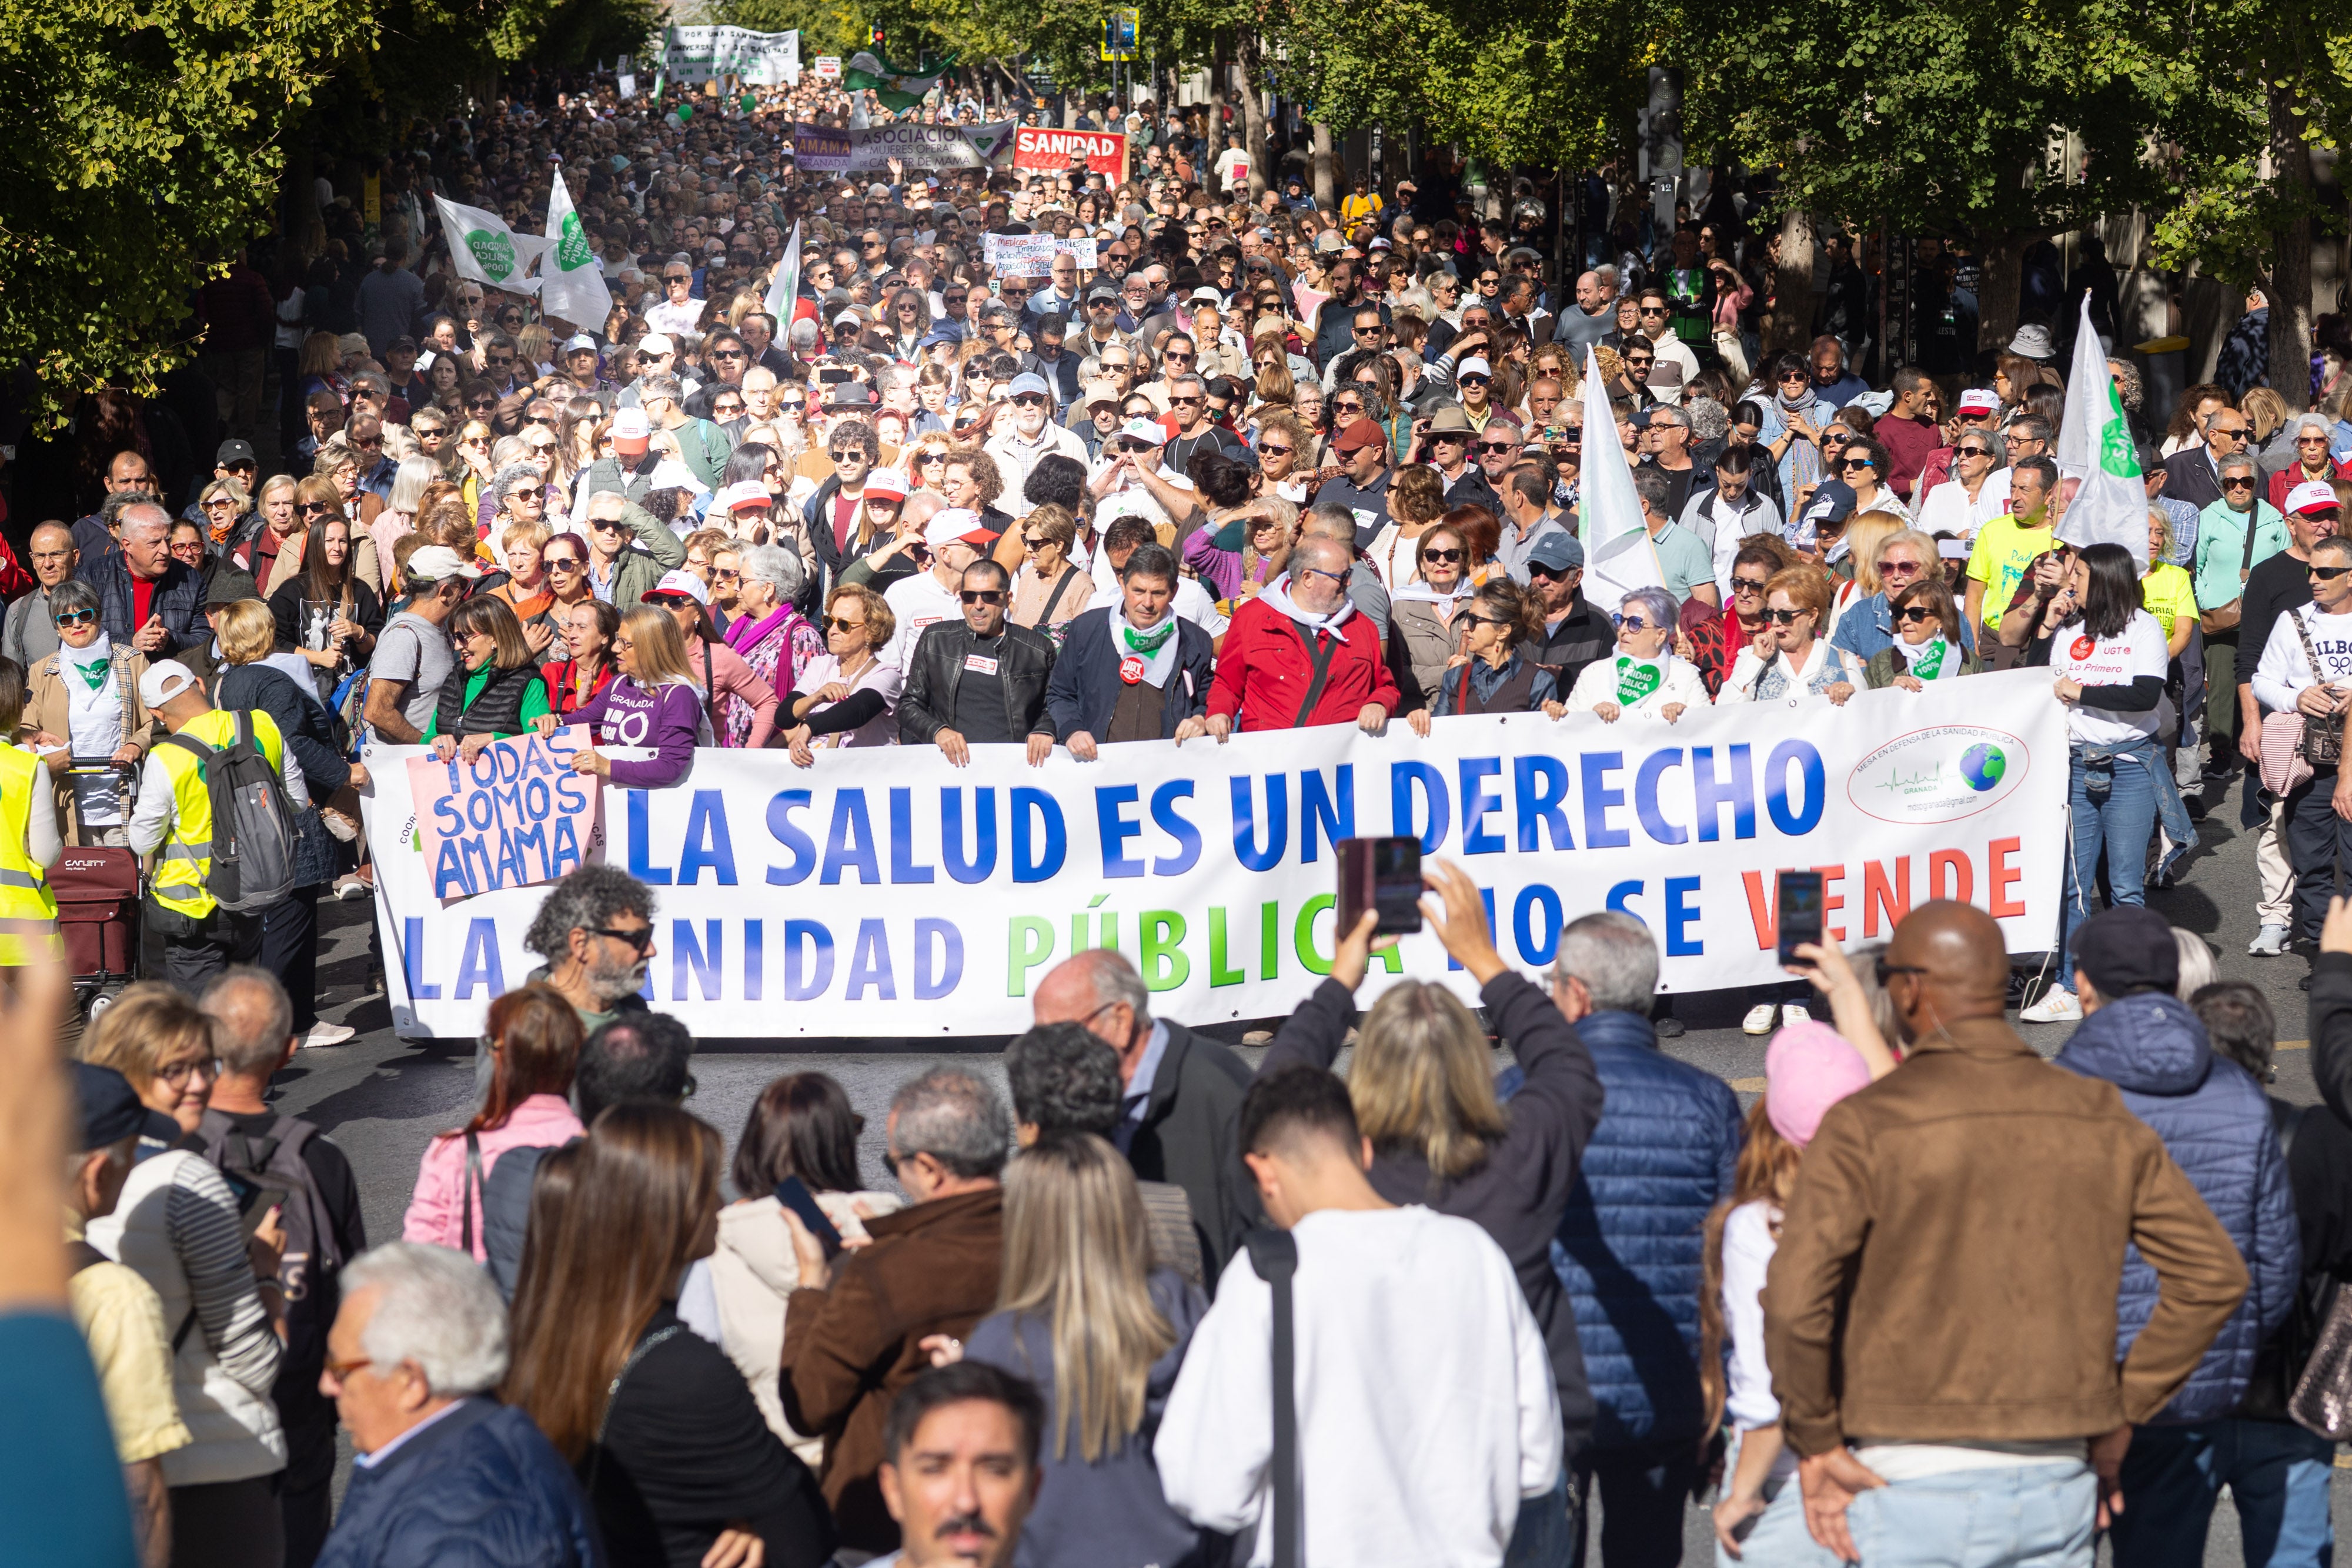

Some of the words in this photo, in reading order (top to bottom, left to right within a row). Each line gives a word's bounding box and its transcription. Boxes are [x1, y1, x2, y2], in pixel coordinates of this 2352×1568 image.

[797, 138, 850, 155] AMAMA
[869, 143, 913, 155] MUJERES
[916, 143, 971, 153] OPERADAS
[1018, 133, 1115, 157] SANIDAD
[799, 157, 848, 169] GRANADA
[918, 155, 931, 166] DE
[934, 156, 971, 166] MAMA
[1661, 183, 1672, 192] 12
[1122, 659, 1142, 674] UGT
[1917, 661, 1940, 676] 100%
[2084, 663, 2123, 673] Primero
[1618, 687, 1641, 699] 100%
[610, 694, 654, 708] GRANADA
[1857, 755, 1877, 774] MESA
[1877, 748, 1889, 758] EN
[1889, 735, 1921, 753] DEFENSA
[1921, 731, 1931, 740] DE
[1932, 729, 1942, 738] LA
[1942, 727, 1979, 737] SANIDAD
[426, 726, 578, 794] TODAS
[1904, 785, 1938, 795] GRANADA
[433, 771, 587, 838] SOMOS
[627, 788, 739, 886] LA
[766, 786, 1067, 886] SALUD
[1094, 778, 1202, 878] ES
[1230, 763, 1355, 872] UN
[1391, 740, 1826, 857] DERECHO
[435, 815, 581, 899] AMAMA
[404, 917, 504, 1000] LA
